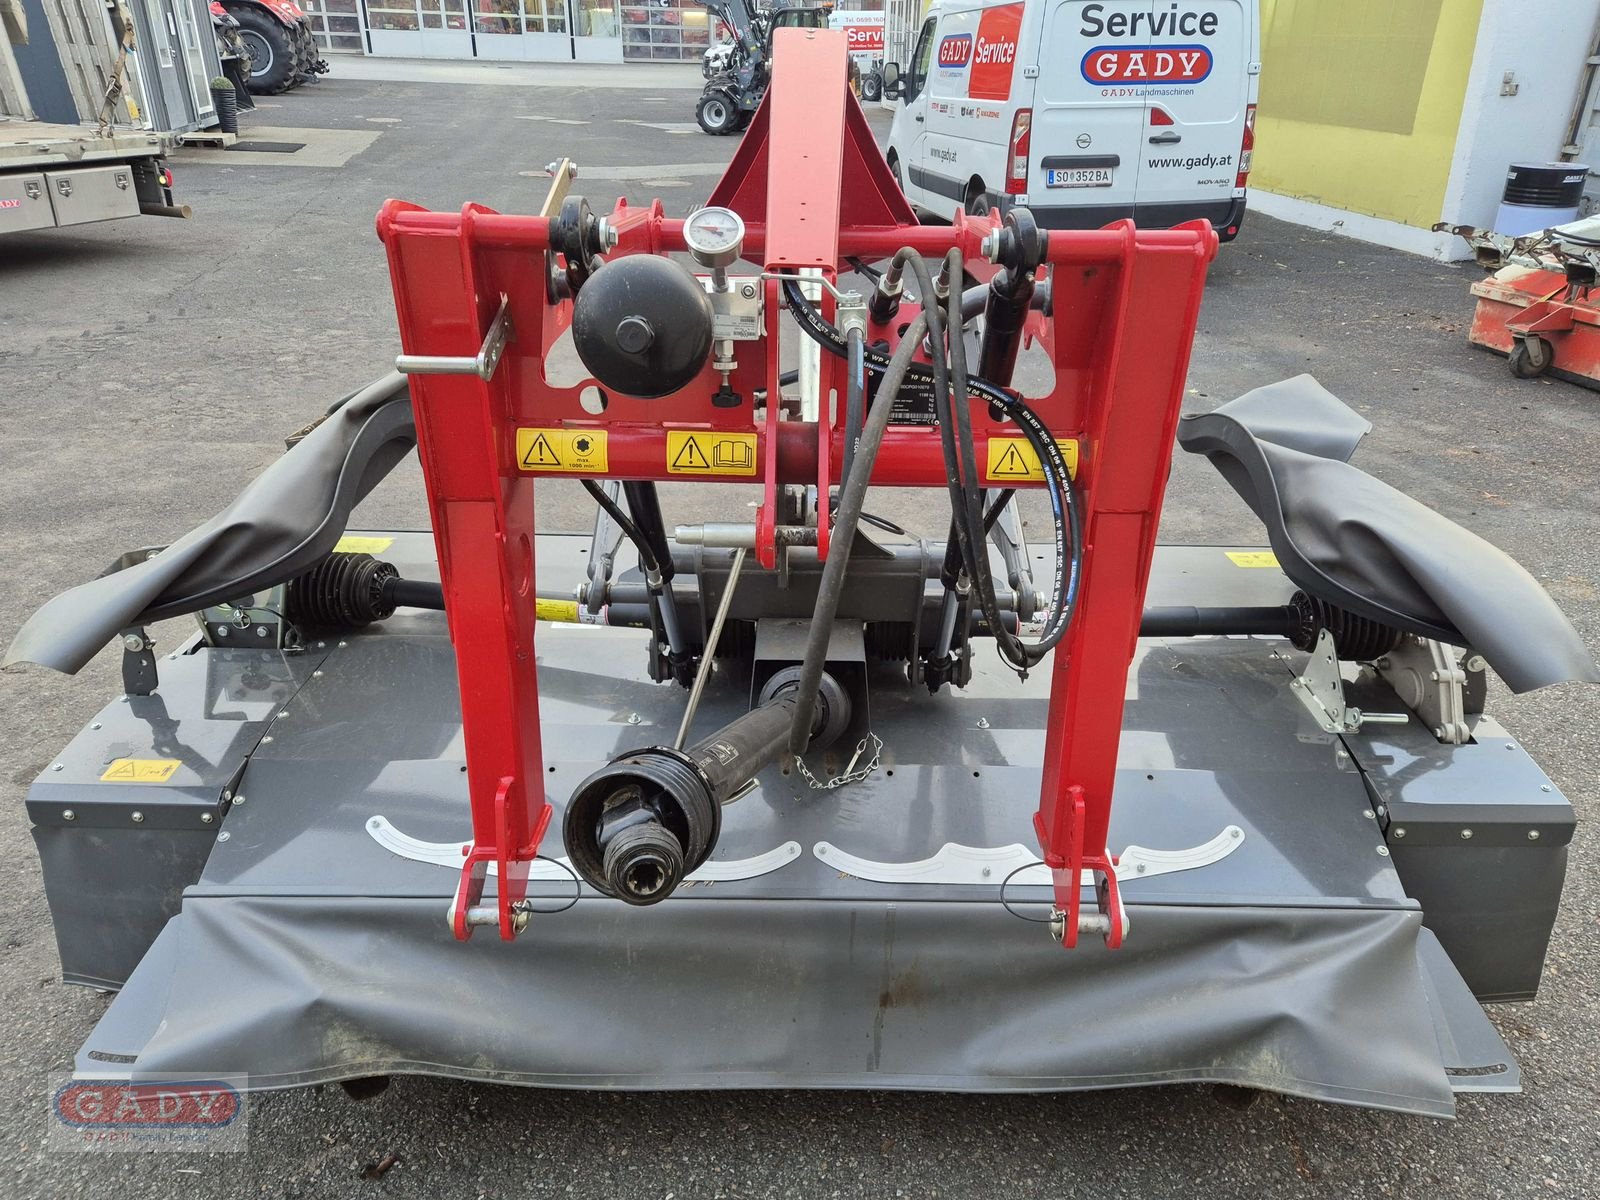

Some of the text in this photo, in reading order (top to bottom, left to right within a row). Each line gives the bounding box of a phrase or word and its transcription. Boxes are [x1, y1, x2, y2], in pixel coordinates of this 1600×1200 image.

[1080, 3, 1218, 37] Service
[941, 40, 970, 61] GADY
[975, 35, 1015, 63] Service
[1096, 52, 1200, 78] GADY
[1101, 87, 1194, 97] GADY Landmaschinen
[1148, 153, 1232, 170] www.gady.at
[1056, 171, 1069, 182] SO
[982, 393, 993, 401] WP
[1022, 410, 1032, 420] EN
[1029, 419, 1041, 429] 857
[1039, 430, 1050, 444] 2SC
[1048, 445, 1056, 456] DN
[1057, 466, 1066, 478] WP
